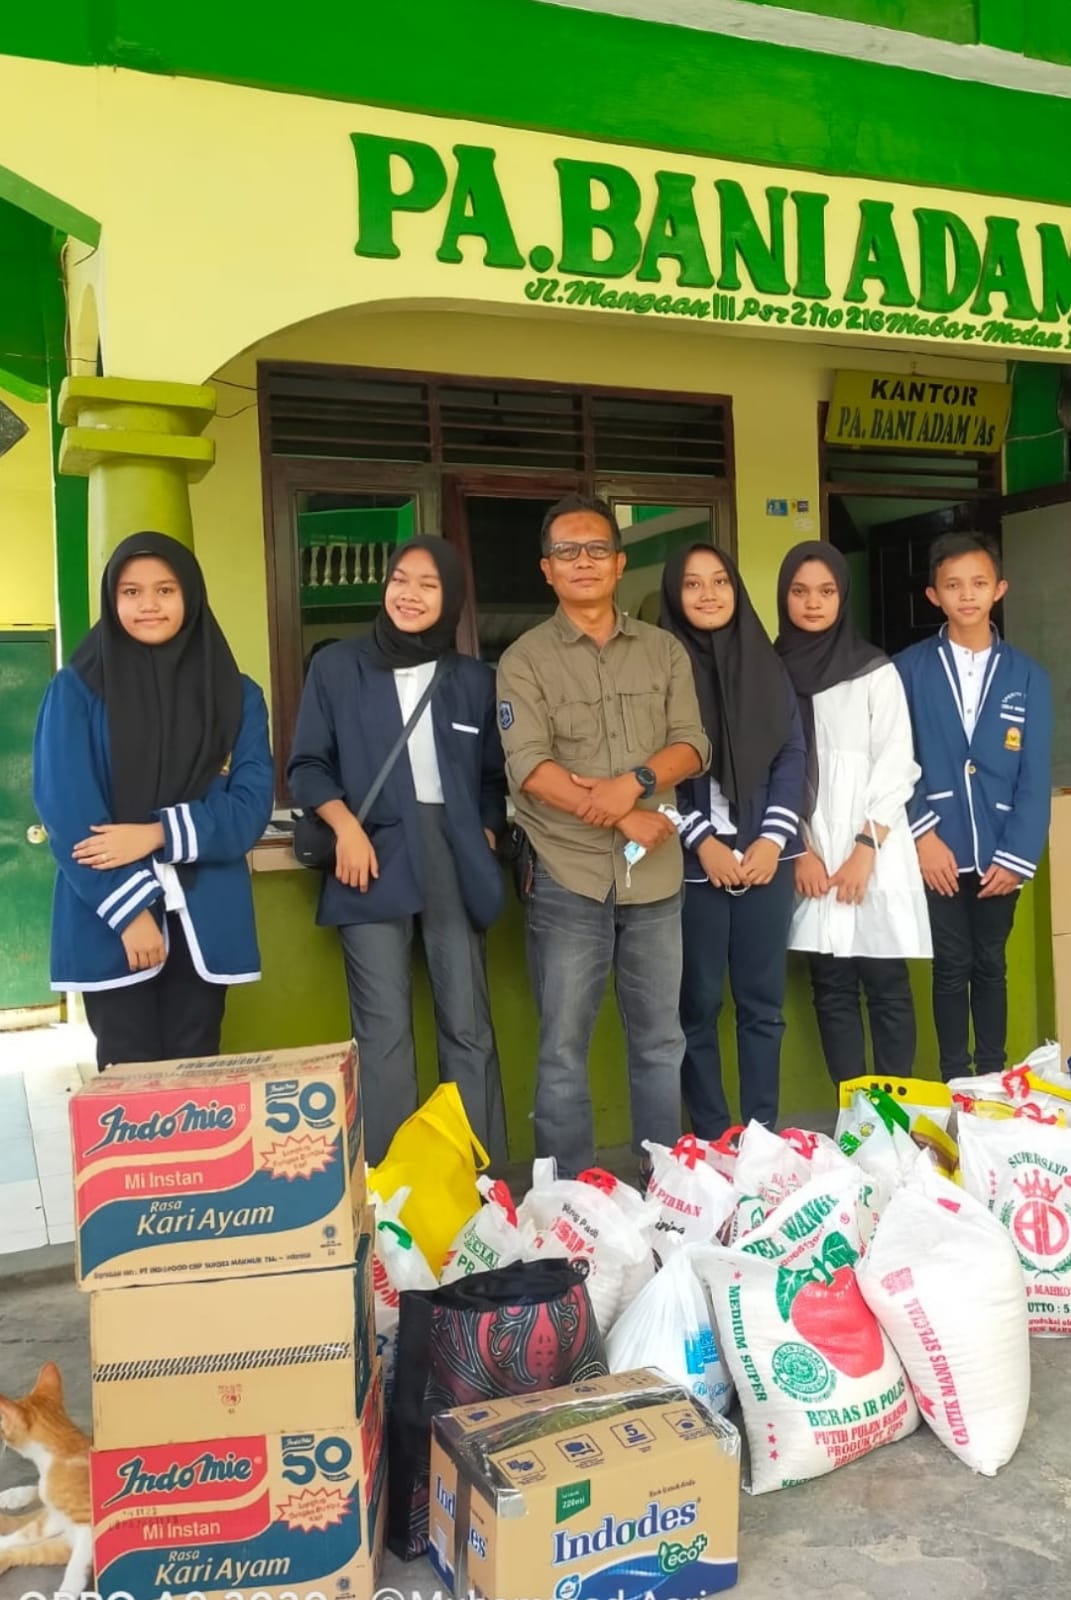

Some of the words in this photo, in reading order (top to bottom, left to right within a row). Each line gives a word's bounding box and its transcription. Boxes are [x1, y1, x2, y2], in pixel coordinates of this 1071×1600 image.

[791, 301, 807, 326] 2
[871, 378, 978, 407] KANTOR
[837, 406, 866, 439] PA.
[870, 408, 915, 442] BANI
[124, 1173, 146, 1190] Mi
[148, 1171, 204, 1188] Instan
[150, 1200, 182, 1214] Rasa
[136, 1212, 194, 1237] Kari
[197, 1205, 275, 1236] Ayam
[729, 1285, 748, 1349] MEDIUM
[740, 1354, 767, 1402] SUPER
[806, 1405, 861, 1427] BERAS
[863, 1400, 879, 1417] IR
[624, 1425, 637, 1437] 5
[143, 1524, 163, 1540] Mi
[167, 1522, 220, 1538] Instan
[553, 1502, 696, 1564] Indodes
[168, 1550, 200, 1562] Rasa
[155, 1561, 211, 1586] Kari
[213, 1556, 290, 1584] Ayam
